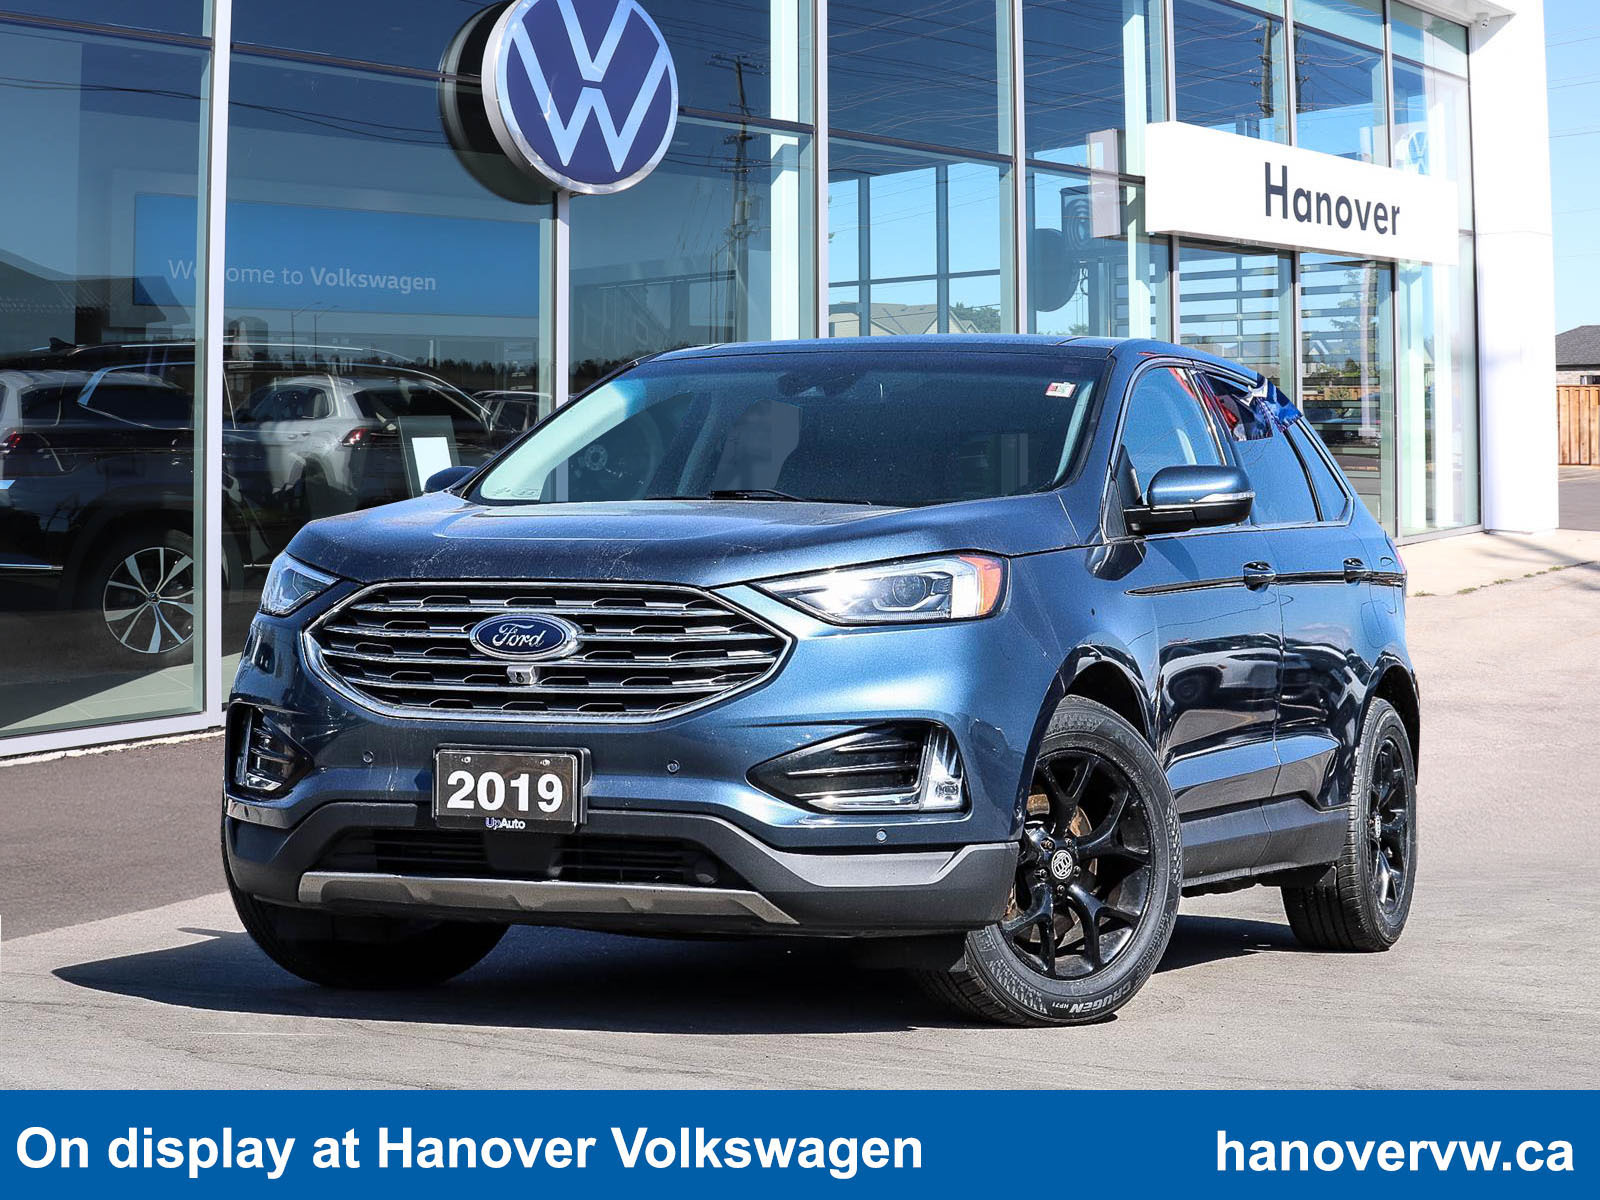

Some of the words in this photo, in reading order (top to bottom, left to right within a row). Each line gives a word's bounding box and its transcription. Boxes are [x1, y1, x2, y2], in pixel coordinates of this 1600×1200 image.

[1264, 161, 1401, 236] Hanover
[167, 259, 275, 284] Wome
[282, 265, 304, 285] to
[309, 266, 437, 294] Volkswagen
[492, 623, 547, 648] Ford
[446, 770, 563, 813] 2019
[485, 817, 526, 830] UpAuto
[1068, 980, 1132, 1014] CRUGEN
